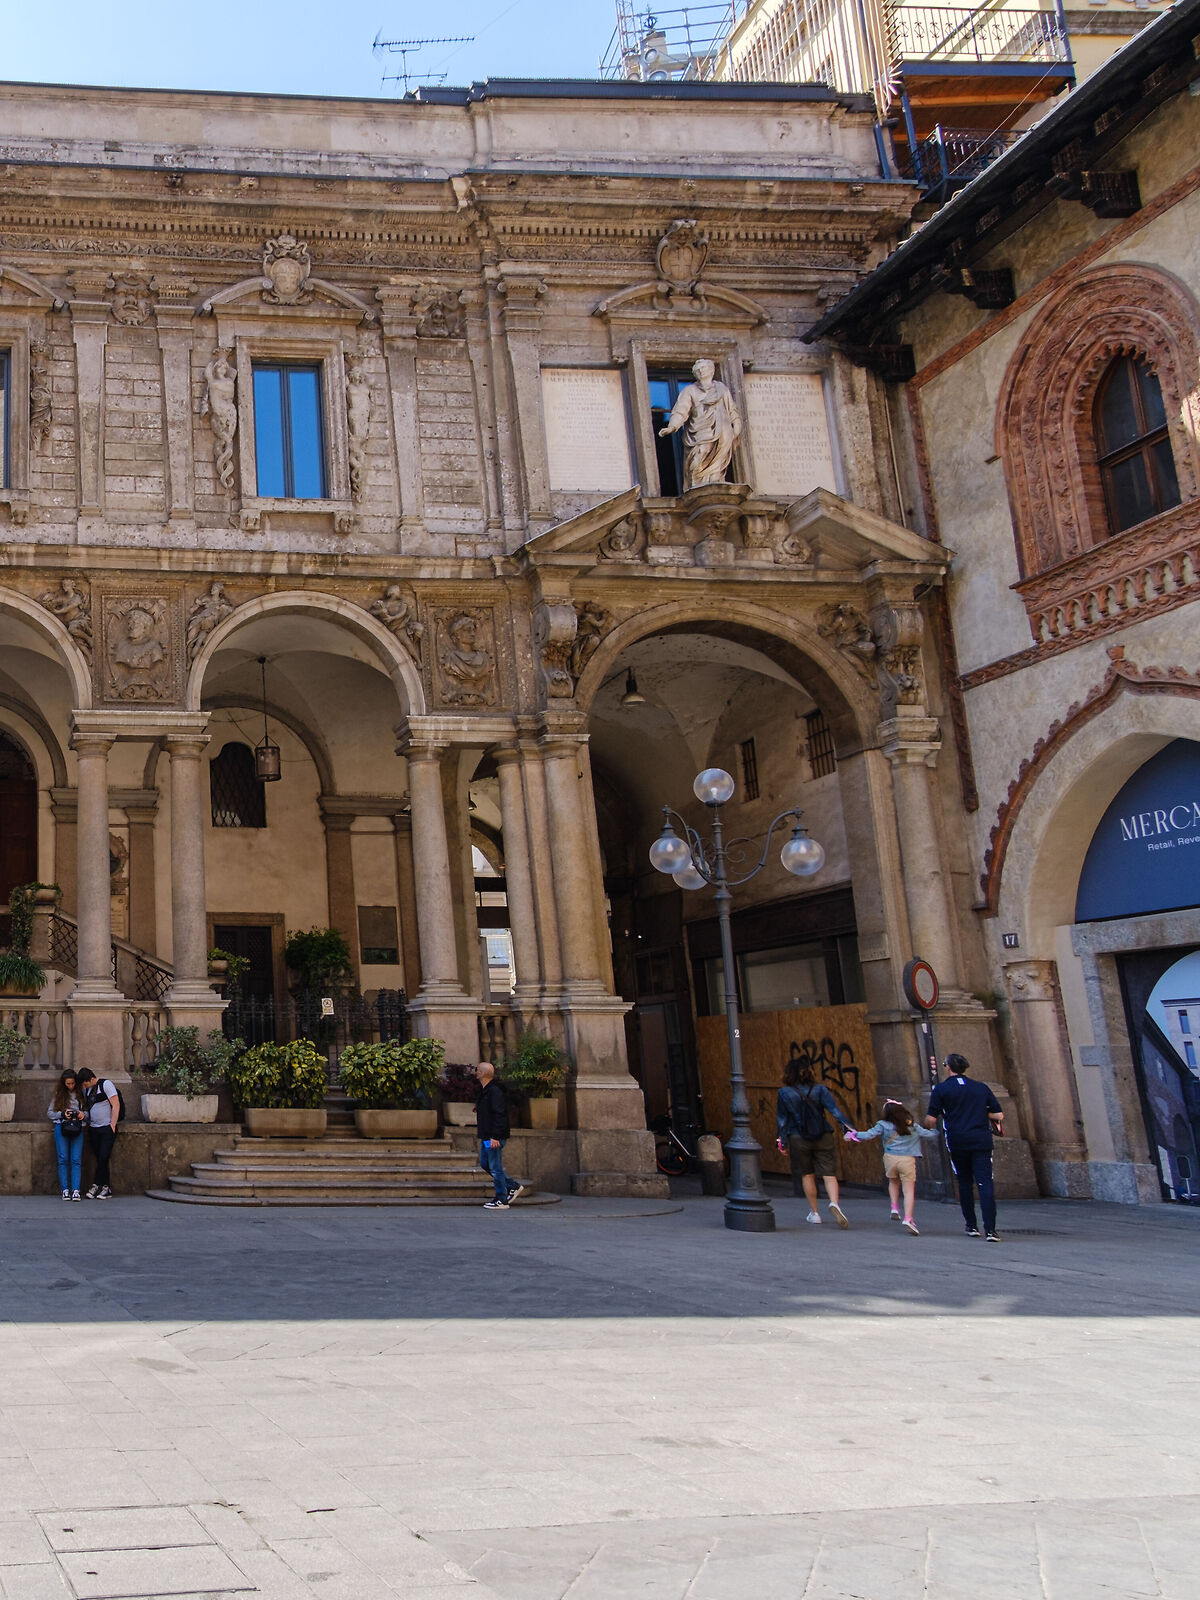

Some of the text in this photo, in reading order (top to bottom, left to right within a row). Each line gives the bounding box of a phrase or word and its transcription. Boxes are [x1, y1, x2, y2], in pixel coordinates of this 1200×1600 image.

[1147, 840, 1176, 851] Retail,
[1005, 935, 1016, 946] 17
[734, 1028, 740, 1038] 2
